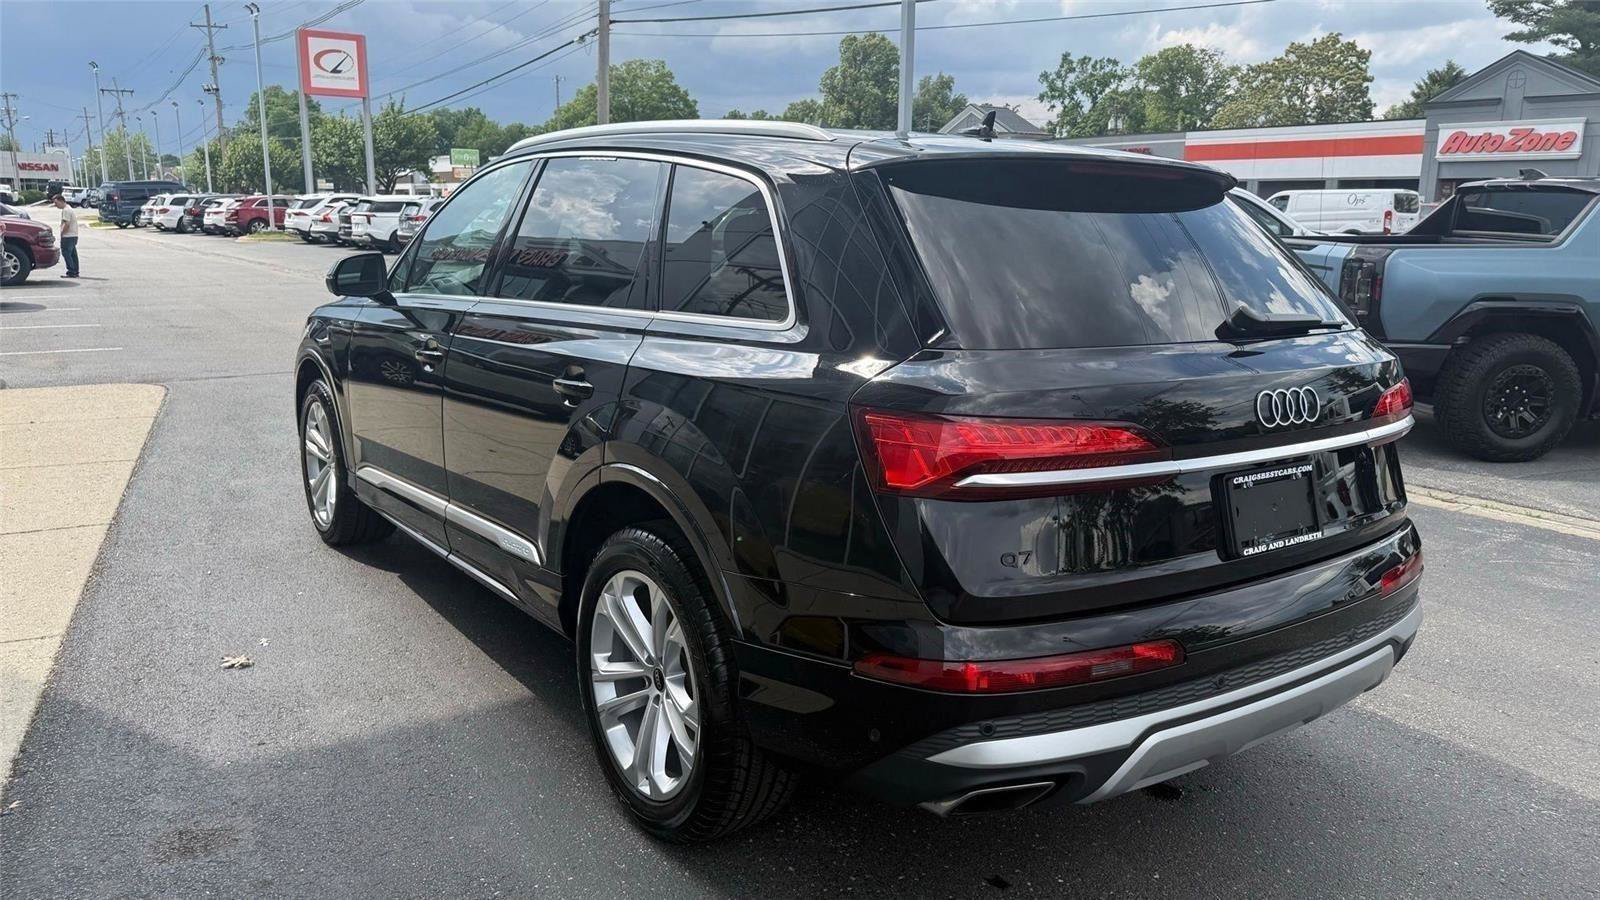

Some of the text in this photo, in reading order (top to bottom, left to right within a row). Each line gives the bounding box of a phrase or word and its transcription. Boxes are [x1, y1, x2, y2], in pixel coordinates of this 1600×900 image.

[1440, 128, 1577, 154] AutoZone
[1233, 465, 1313, 484] CRAIGSBESTCARS.COM
[1243, 532, 1322, 556] CRAIG AND LANDRETH
[1000, 550, 1032, 568] Q7
